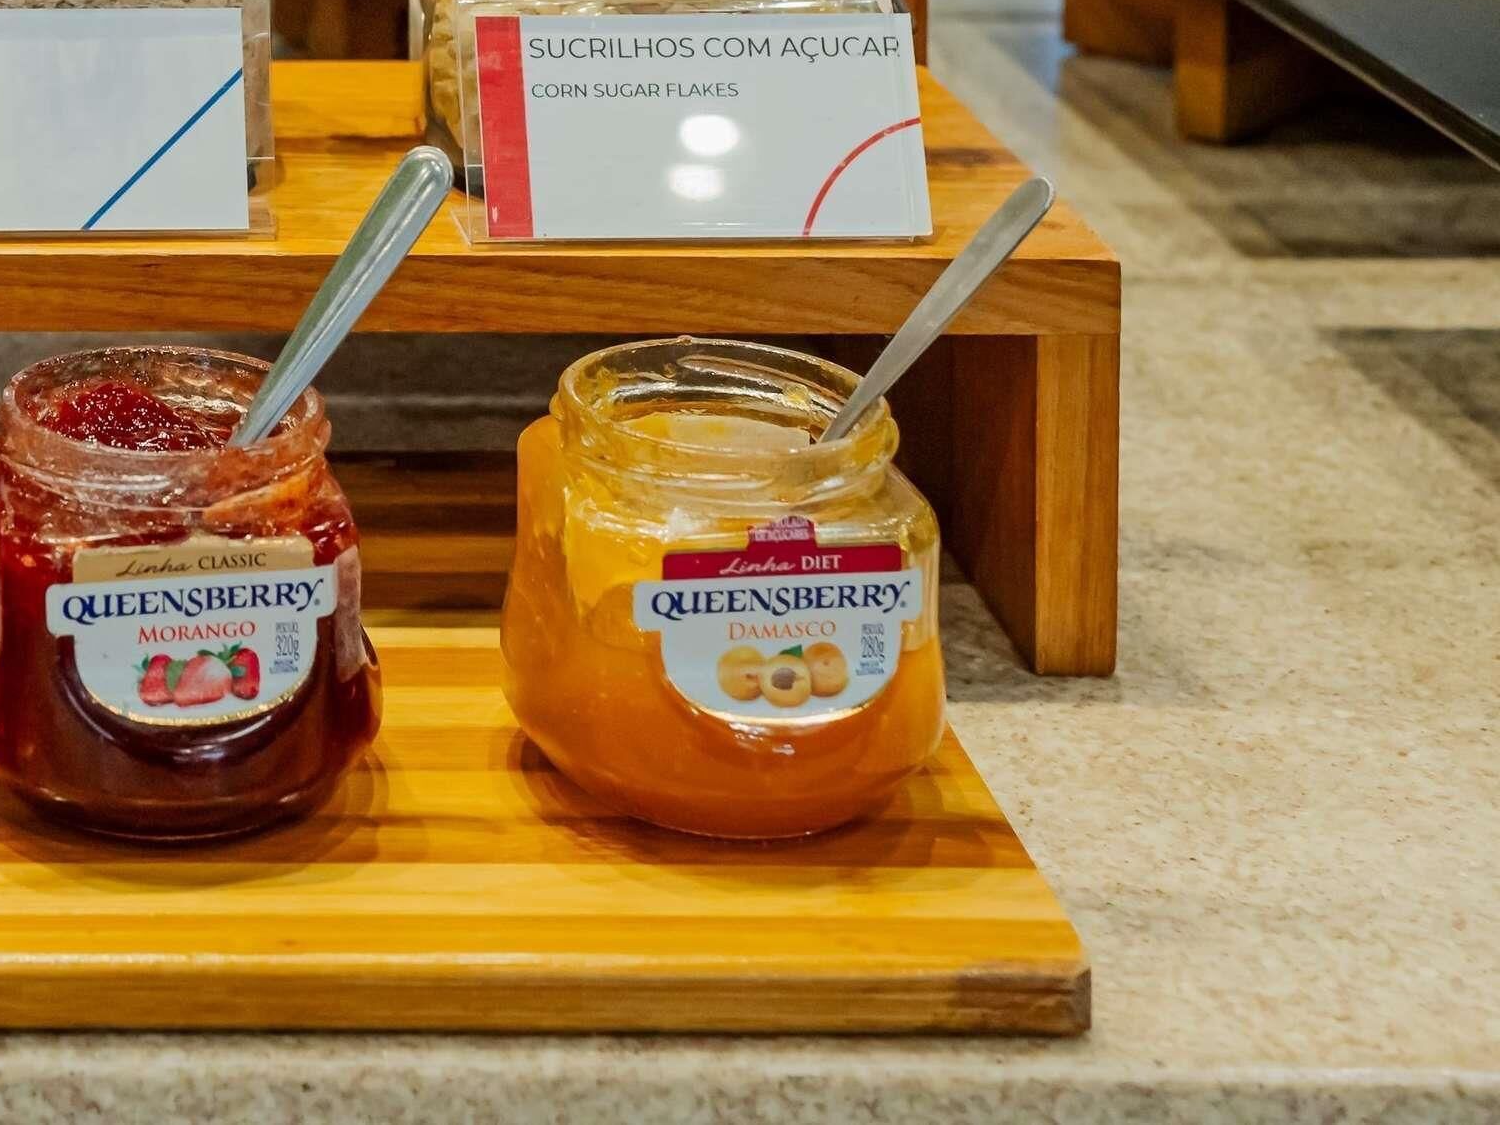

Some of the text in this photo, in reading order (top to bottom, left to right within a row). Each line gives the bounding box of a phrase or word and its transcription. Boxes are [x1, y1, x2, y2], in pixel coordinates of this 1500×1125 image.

[529, 37, 695, 59] SUCRILHOS
[703, 36, 772, 58] COM
[531, 82, 739, 99] CORN SUGAR FLAKES
[116, 552, 267, 578] Linha CLASSIC
[719, 554, 842, 575] Linha DIET
[62, 578, 324, 625] QUEENSBERRY
[651, 580, 911, 621] QUEENSBERRY
[137, 620, 256, 645] MORANGO
[729, 620, 837, 641] DAMASCO
